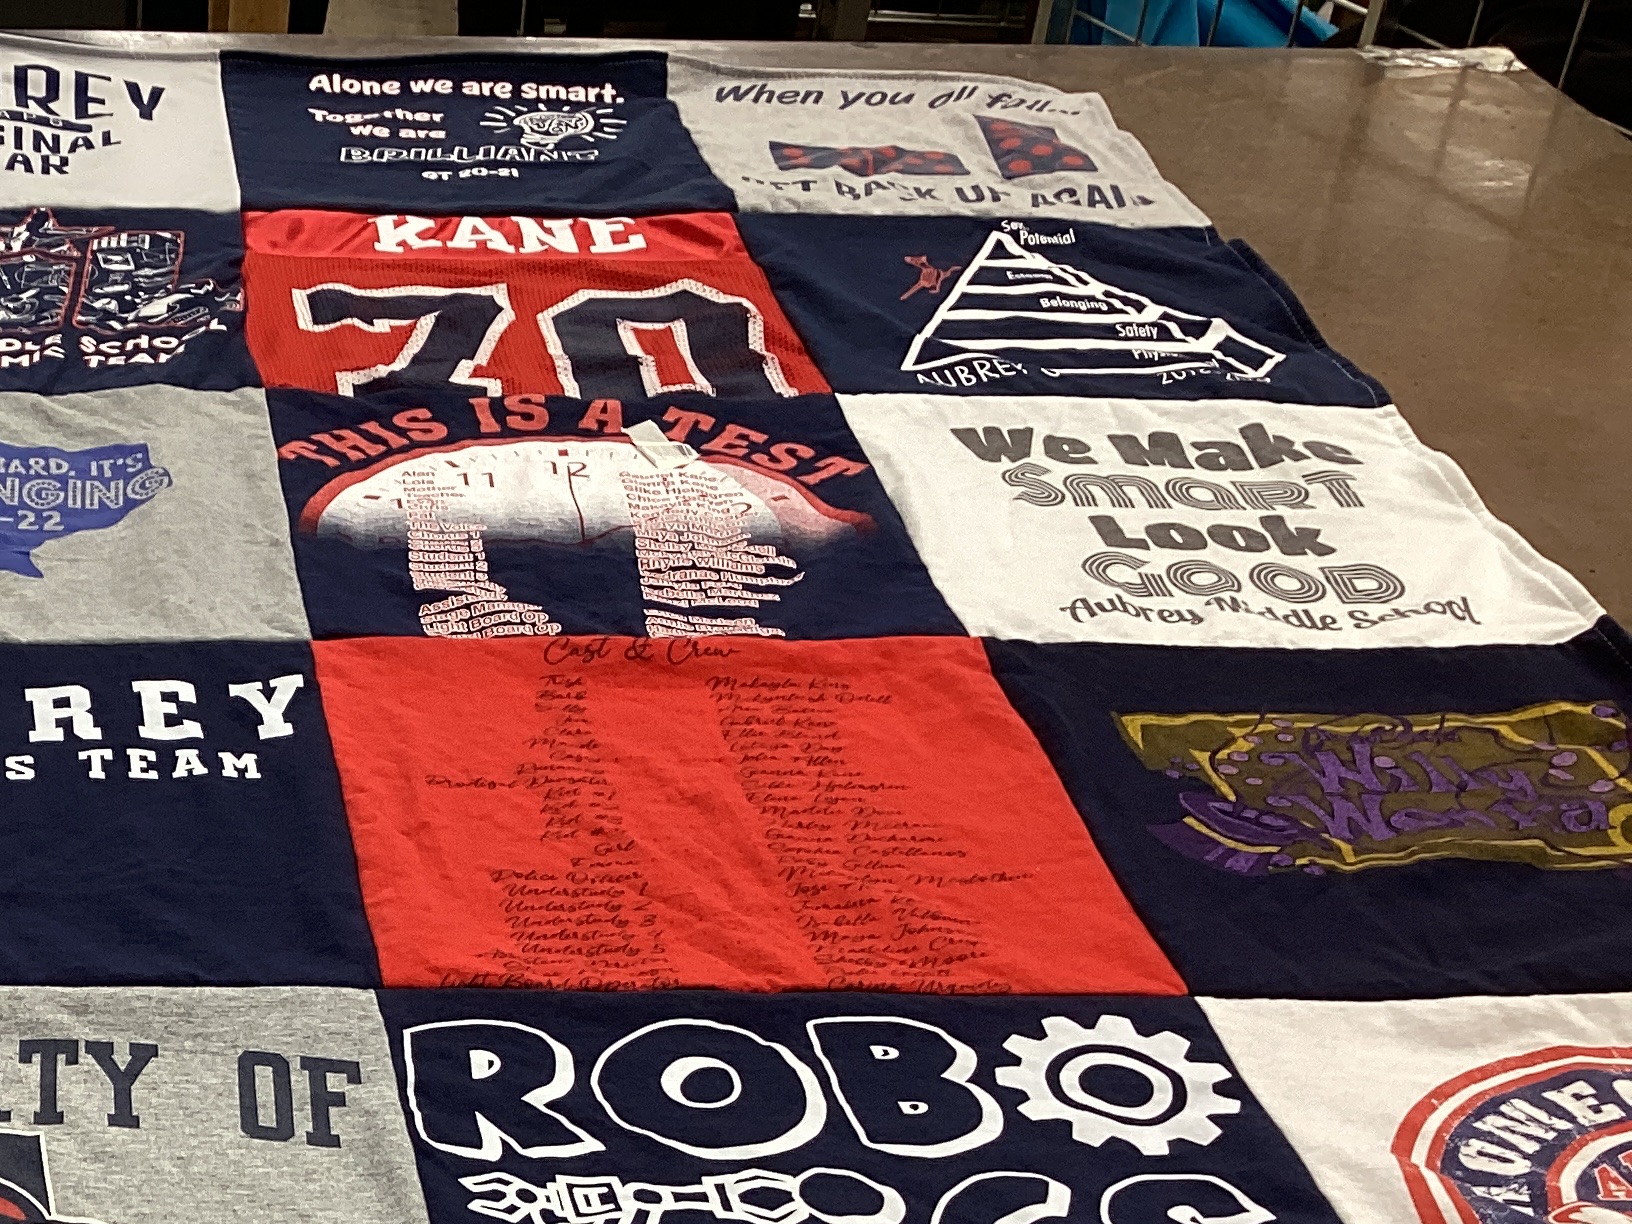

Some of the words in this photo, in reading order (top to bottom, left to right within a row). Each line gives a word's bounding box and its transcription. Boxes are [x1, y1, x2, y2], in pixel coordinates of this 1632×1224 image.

[309, 74, 400, 96] Alone
[409, 78, 452, 95] we
[462, 79, 511, 99] are
[521, 81, 625, 104] smart.
[715, 84, 823, 106] When
[840, 88, 916, 110] you
[928, 84, 979, 110] all
[350, 124, 389, 138] we
[399, 127, 446, 139] are
[374, 214, 647, 254] KANE
[1019, 227, 1076, 246] Potential
[1039, 296, 1109, 311] Belonging
[292, 278, 799, 400] 70
[1115, 323, 1158, 340] Safety
[278, 408, 449, 468] THIS
[469, 393, 550, 433] IS
[578, 398, 623, 433] A
[662, 406, 869, 486] TEST
[950, 426, 1098, 466] We
[1107, 421, 1364, 471] Make
[90, 453, 143, 477] IT'S
[1088, 514, 1338, 558] Look
[408, 551, 475, 562] Student
[1081, 551, 1406, 604] GOOD
[468, 611, 521, 632] Board
[1060, 593, 1205, 627] Aubrey
[1204, 595, 1343, 632] Middle
[1350, 596, 1482, 631] School
[543, 637, 611, 666] Cast
[667, 637, 742, 666] Crew
[77, 748, 263, 782] TEAM
[236, 1049, 363, 1149] OF
